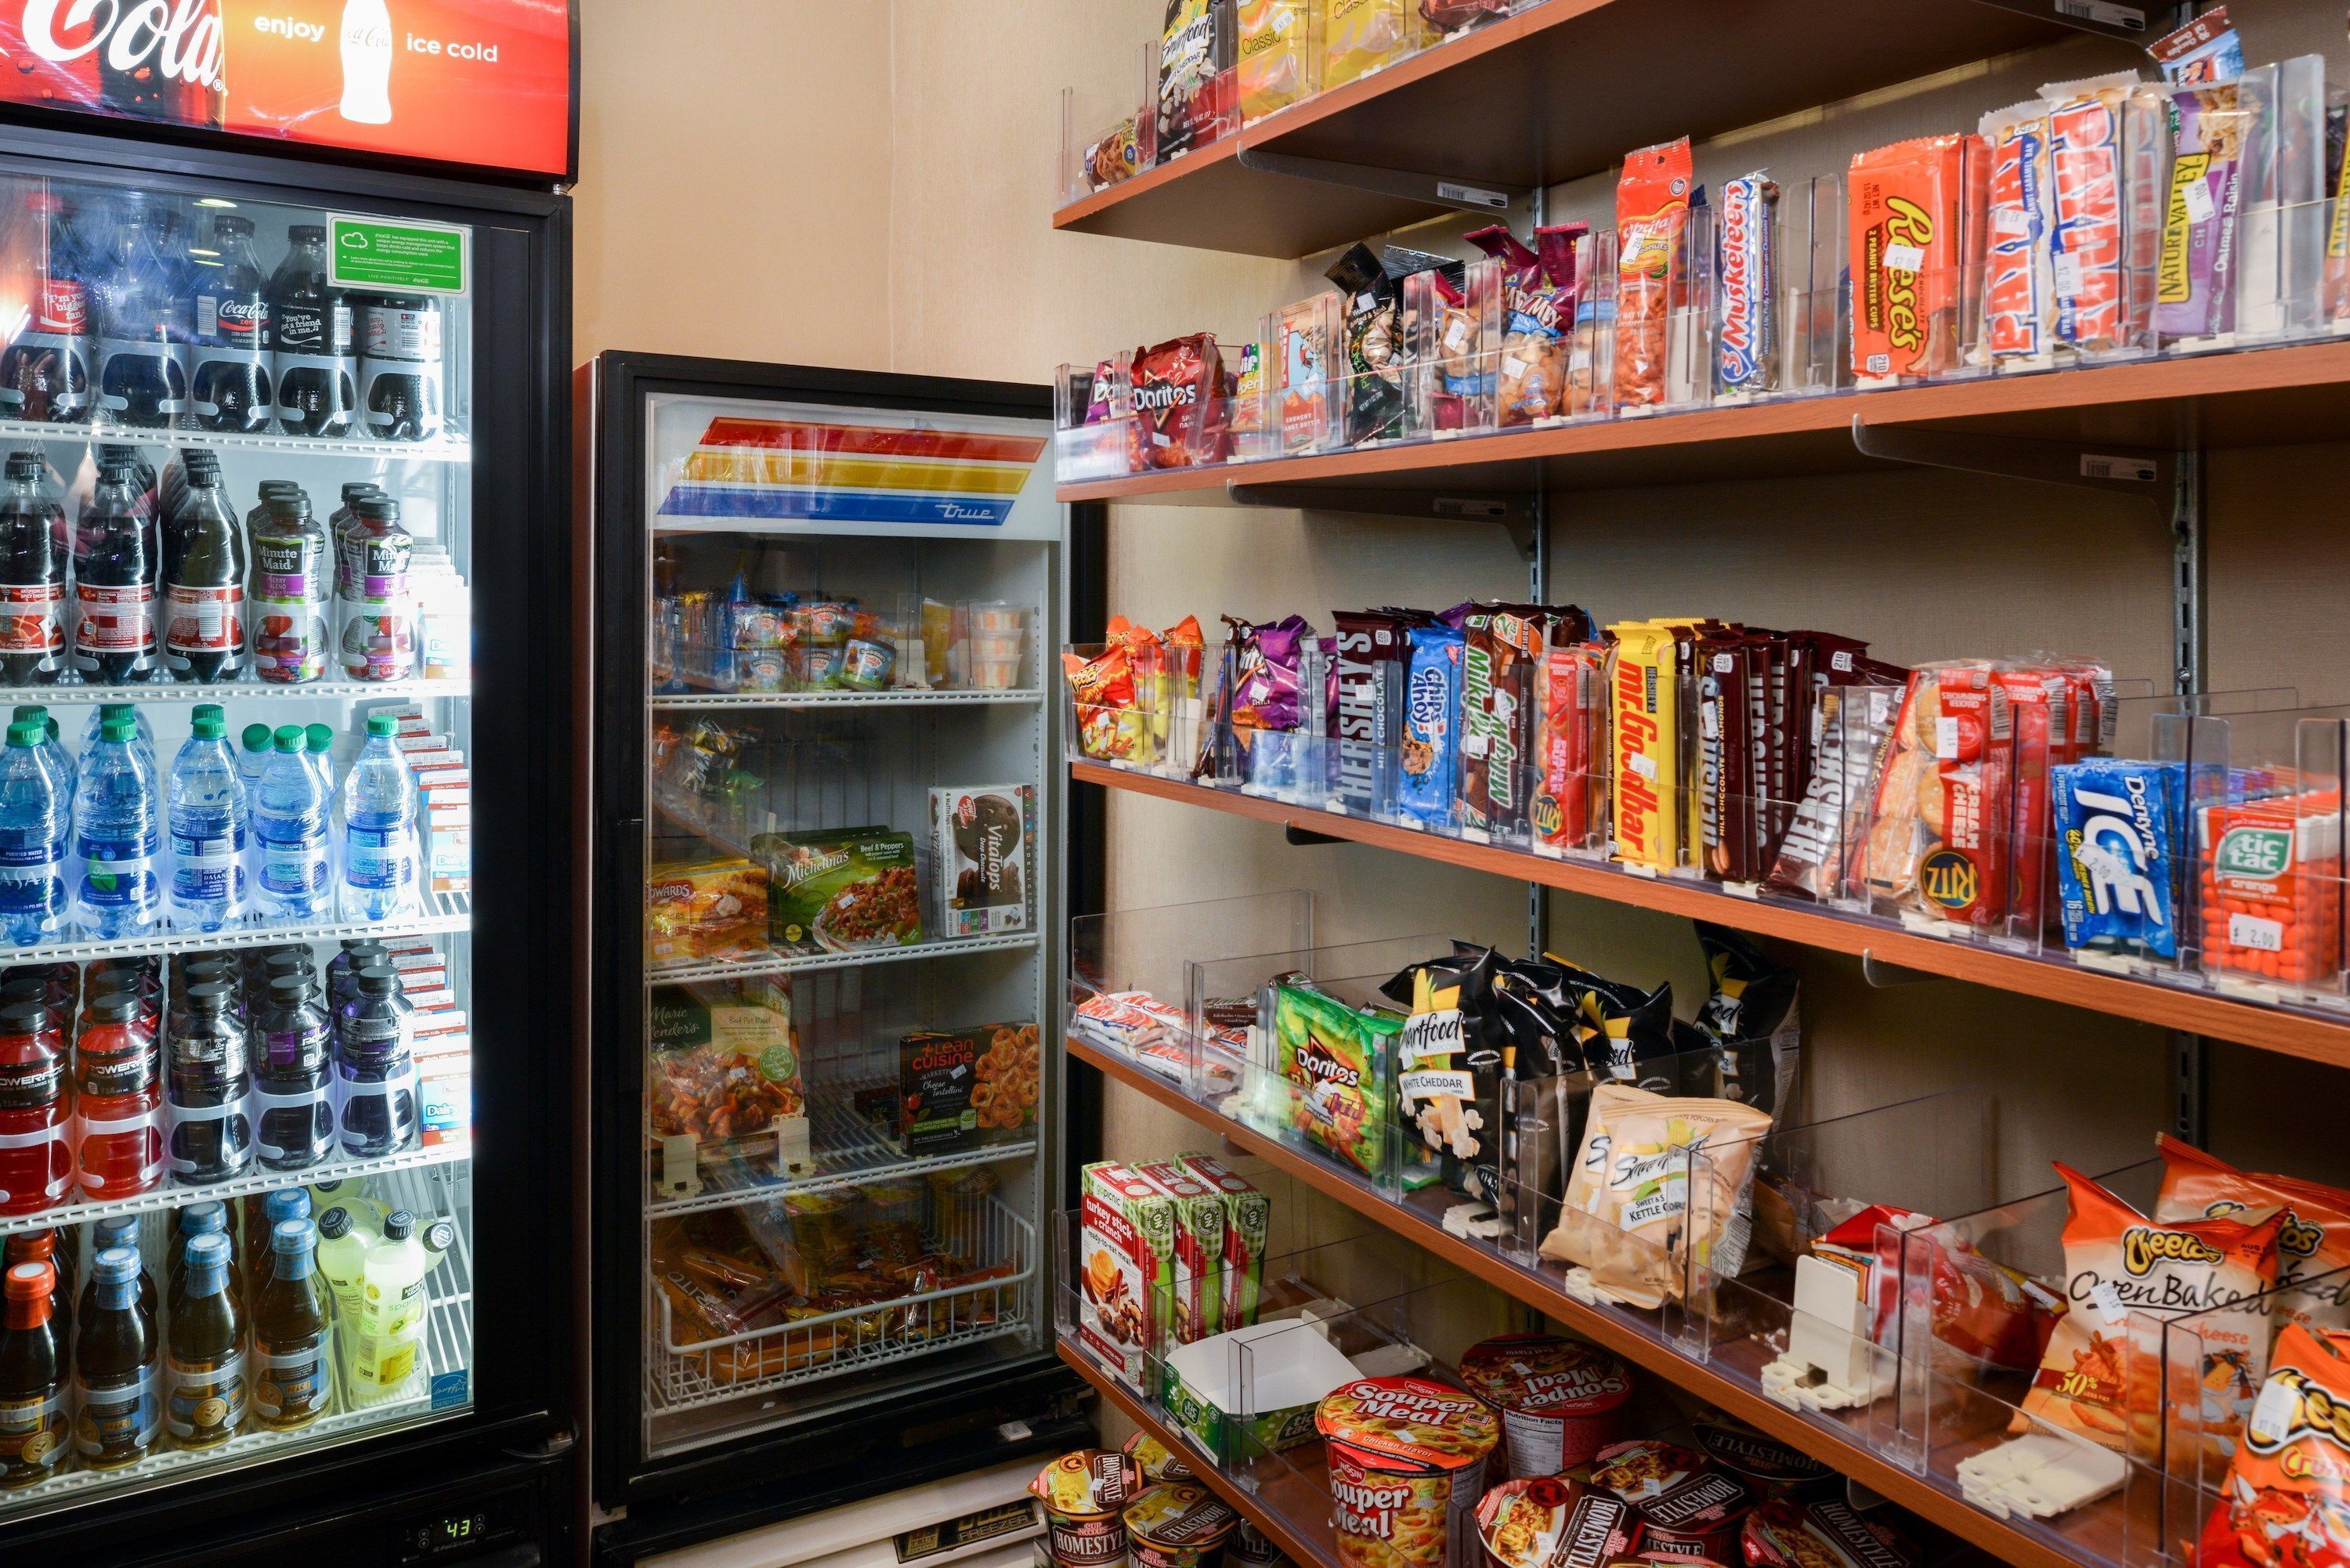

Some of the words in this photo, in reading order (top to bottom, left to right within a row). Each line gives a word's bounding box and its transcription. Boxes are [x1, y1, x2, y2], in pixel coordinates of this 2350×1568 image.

[255, 14, 325, 43] enjoy
[1162, 14, 1212, 66] Smartfood
[407, 32, 442, 56] ice
[446, 36, 498, 63] cold
[1242, 29, 1281, 56] Classic
[1177, 52, 1201, 74] CHEDDAR
[2023, 158, 2034, 191] CARAMEL
[1873, 198, 1879, 210] WT
[2170, 157, 2204, 229] VALLEY
[2223, 173, 2239, 217] Raisin
[2025, 192, 2037, 220] PEANUT
[1723, 181, 1750, 348] Musketeers
[1868, 236, 1878, 270] PEANUT
[2159, 226, 2186, 302] NATURE
[1868, 271, 1878, 299] BUTTER
[219, 299, 269, 321] Coca-Cola
[1869, 301, 1878, 328] CUPS
[1725, 345, 1747, 376] 3
[1876, 356, 1888, 373] 210
[1134, 382, 1196, 411] Doritos
[1285, 413, 1312, 424] CRUNCHY
[258, 546, 298, 558] Minute
[1716, 656, 1724, 671] 210
[1833, 653, 1845, 671] 210
[1424, 667, 1448, 723] Chips
[1646, 666, 1658, 714] HERSHEY'S
[1942, 692, 1987, 702] SANDWICHES
[1340, 631, 1372, 797] HERSHEY'S
[1949, 699, 1981, 709] CRACKER
[1877, 724, 1894, 768] ALMONDS
[1489, 741, 1517, 810] Milky
[1620, 711, 1658, 858] Goodbar
[1536, 802, 1563, 830] RITZ
[1951, 783, 1966, 849] CHEESE
[1967, 781, 1980, 850] CREAM
[2123, 775, 2160, 861] Dentyne
[880, 842, 904, 852] Peppers
[2073, 787, 2164, 927] ICE
[2240, 833, 2283, 856] tic
[782, 851, 850, 889] Michelina's
[988, 825, 1003, 891] VitaTops
[2229, 847, 2280, 871] tac
[650, 884, 689, 899] DWARDS
[1926, 862, 1977, 902] RITZ
[2231, 878, 2278, 894] orange
[2250, 928, 2276, 948] 2.00
[651, 1006, 688, 1024] Marie
[935, 1039, 974, 1055] Lean
[1428, 1043, 1462, 1053] POPCORN
[1297, 1047, 1359, 1086] Doritos
[923, 1080, 945, 1090] Cheese
[932, 1086, 964, 1097] Tortellini
[1402, 1078, 1420, 1091] WHITE
[1420, 1075, 1463, 1089] CHEDDAR
[1690, 1113, 1716, 1125] POPCORN
[1629, 1207, 1662, 1223] KETTLE
[1662, 1201, 1686, 1213] COR
[1636, 1197, 1654, 1209] SWEET
[1086, 1198, 1111, 1223] turkey
[1111, 1210, 1133, 1241] stick
[1098, 1219, 1123, 1245] crunch
[1087, 1230, 1118, 1255] ready-to-eat
[1118, 1250, 1132, 1266] meal
[2124, 1227, 2225, 1277] Cheetos
[2241, 1243, 2261, 1252] AUG
[2161, 1271, 2273, 1317] Baked
[1408, 1383, 1437, 1396] NISSIN
[1521, 1378, 1625, 1408] Souper
[1524, 1367, 1598, 1394] Meal
[2055, 1371, 2098, 1396] 50%
[432, 1398, 452, 1407] ENERGY
[1349, 1385, 1476, 1413] Souper
[2084, 1391, 2099, 1400] LESS
[1292, 1411, 1315, 1425] tic
[1358, 1400, 1447, 1425] Meal
[1506, 1409, 1538, 1422] Nutrition
[1540, 1416, 1564, 1426] Facts
[1285, 1422, 1311, 1437] tac
[1362, 1435, 1401, 1449] Chicken
[1402, 1444, 1434, 1458] Flavor
[1708, 1432, 1828, 1474] HOMESTYLE
[1102, 1455, 1121, 1501] HOMESTYLE
[1340, 1461, 1363, 1479] NISSIN
[1332, 1487, 1409, 1515] ouper
[1648, 1479, 1738, 1523] HOMESTYLE
[446, 1519, 470, 1537] 43
[960, 1516, 1029, 1541] FREEZER
[1077, 1526, 1108, 1537] NOODLES
[1163, 1505, 1225, 1541] HOMESTYLE
[911, 1535, 935, 1545] TRUE
[1056, 1534, 1126, 1555] HOMESTYL
[1139, 1553, 1167, 1567] NOODLES
[1144, 1548, 1161, 1559] CUP
